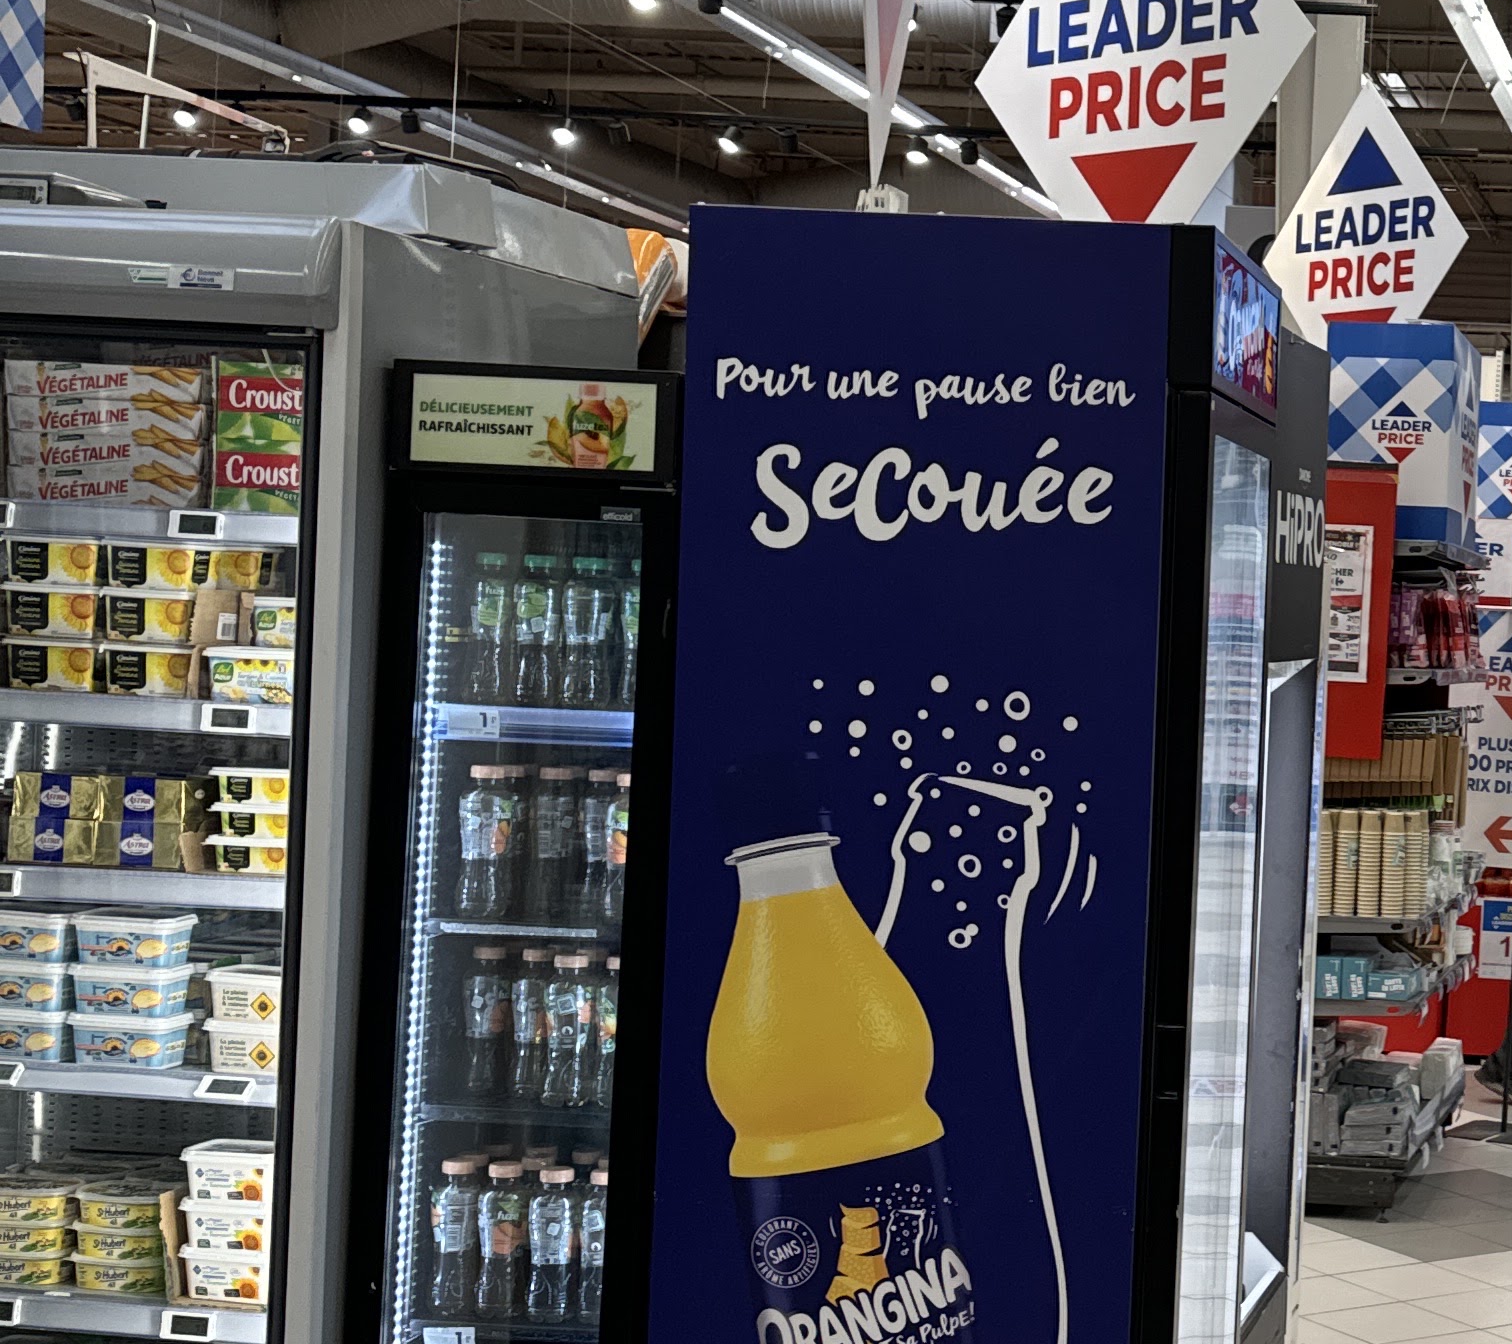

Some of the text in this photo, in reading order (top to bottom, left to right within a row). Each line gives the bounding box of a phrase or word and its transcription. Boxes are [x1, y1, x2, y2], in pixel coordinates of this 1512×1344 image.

[1048, 53, 1227, 139] PRICE
[1295, 195, 1435, 254] LEADER
[1307, 249, 1416, 302] PRICE
[36, 372, 129, 395] VÉGÉTALINE
[716, 357, 1136, 420] Pour une pause bien
[419, 398, 534, 417] DÉLICIEUSEMENT
[39, 408, 130, 430] VÉGÉTALINE
[419, 419, 534, 436] RAFRAÎCHISSANT
[1371, 419, 1432, 432] LEADER
[1378, 433, 1424, 445] PRICE
[40, 444, 131, 466] VÉGÉTALINE
[38, 479, 129, 501] VÉGÉTALINE
[751, 437, 1114, 549] SeCouée
[1275, 490, 1325, 568] HiPRO
[1468, 753, 1492, 772] 00
[1467, 778, 1490, 792] RIX
[4, 1199, 31, 1209] Hubert
[104, 1206, 130, 1217] Hubert
[3, 1231, 30, 1242] Hubert
[100, 1237, 127, 1248] Hubert
[755, 1220, 799, 1246] COLORANT
[769, 1240, 801, 1264] SANS
[102, 1269, 129, 1279] Hubert
